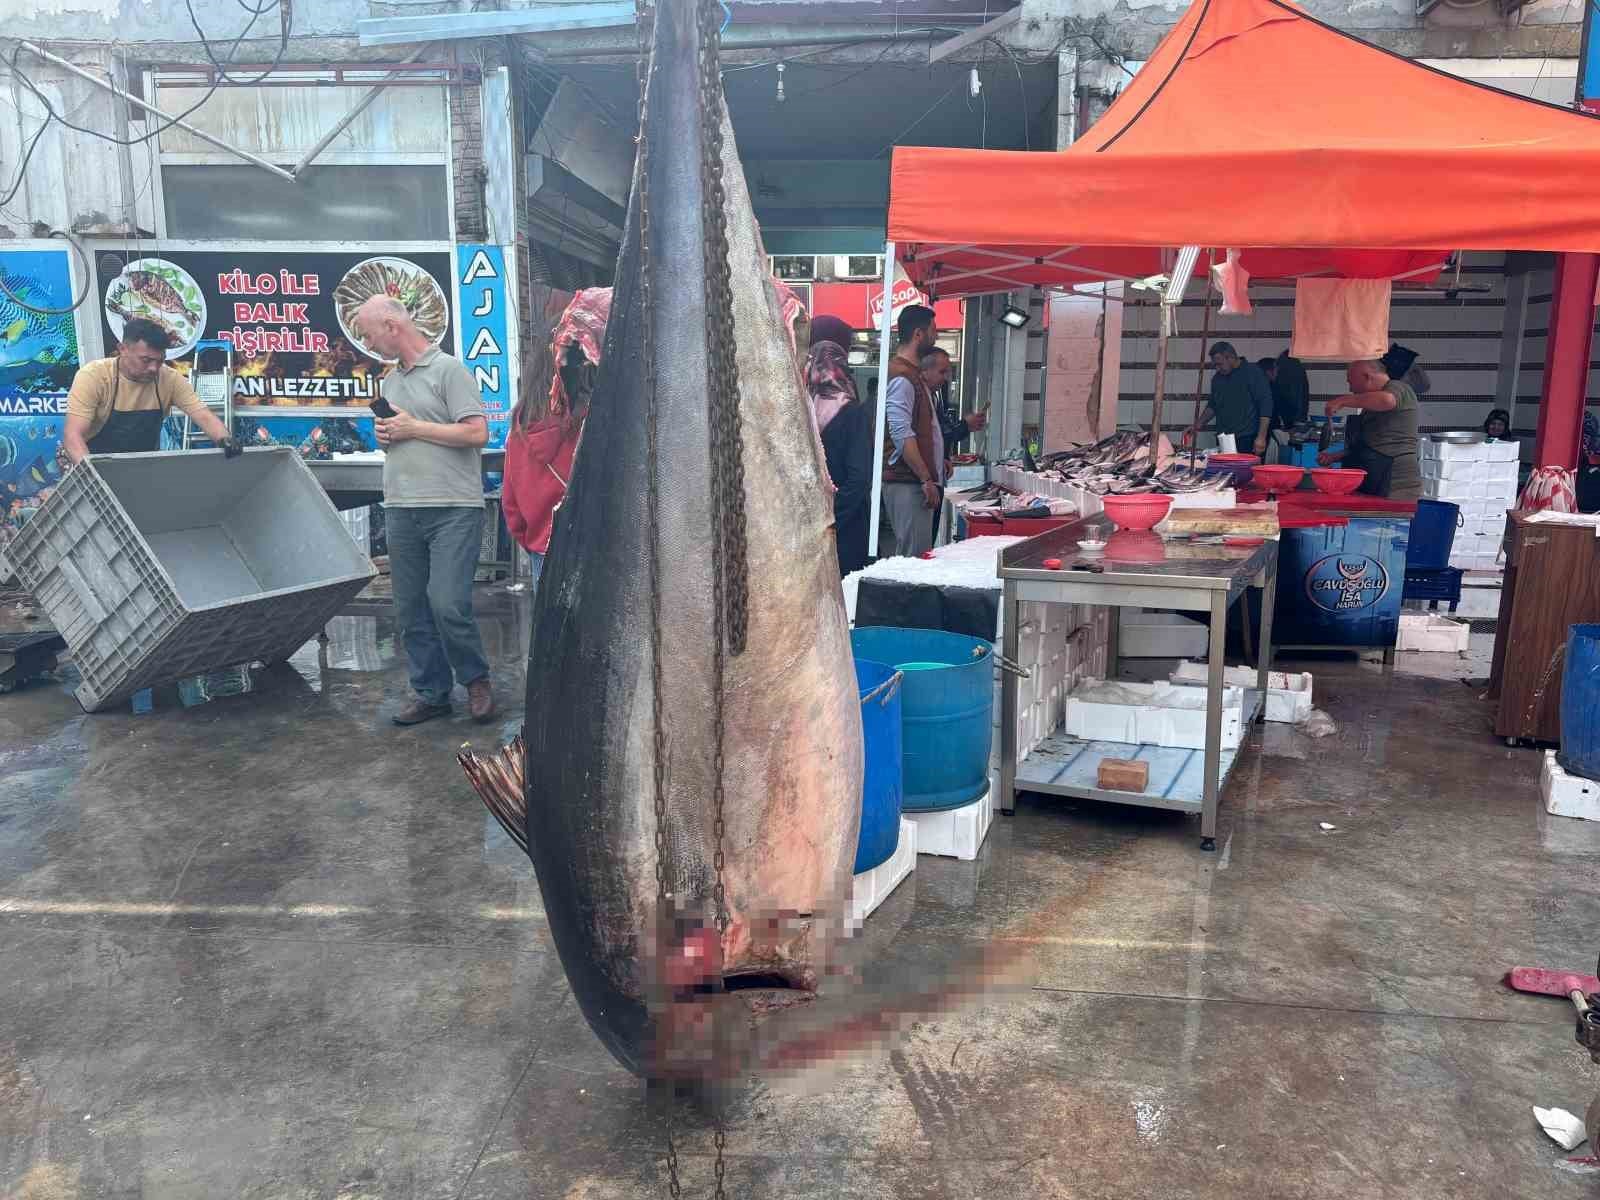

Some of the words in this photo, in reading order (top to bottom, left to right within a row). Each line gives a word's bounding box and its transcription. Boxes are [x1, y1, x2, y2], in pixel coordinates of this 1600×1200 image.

[218, 268, 278, 295] KİLO
[280, 268, 320, 295] İLE
[875, 287, 916, 312] Ksap
[234, 303, 310, 323] BALIK
[462, 250, 503, 394] AJAN
[271, 375, 373, 396] LEZZETLİ
